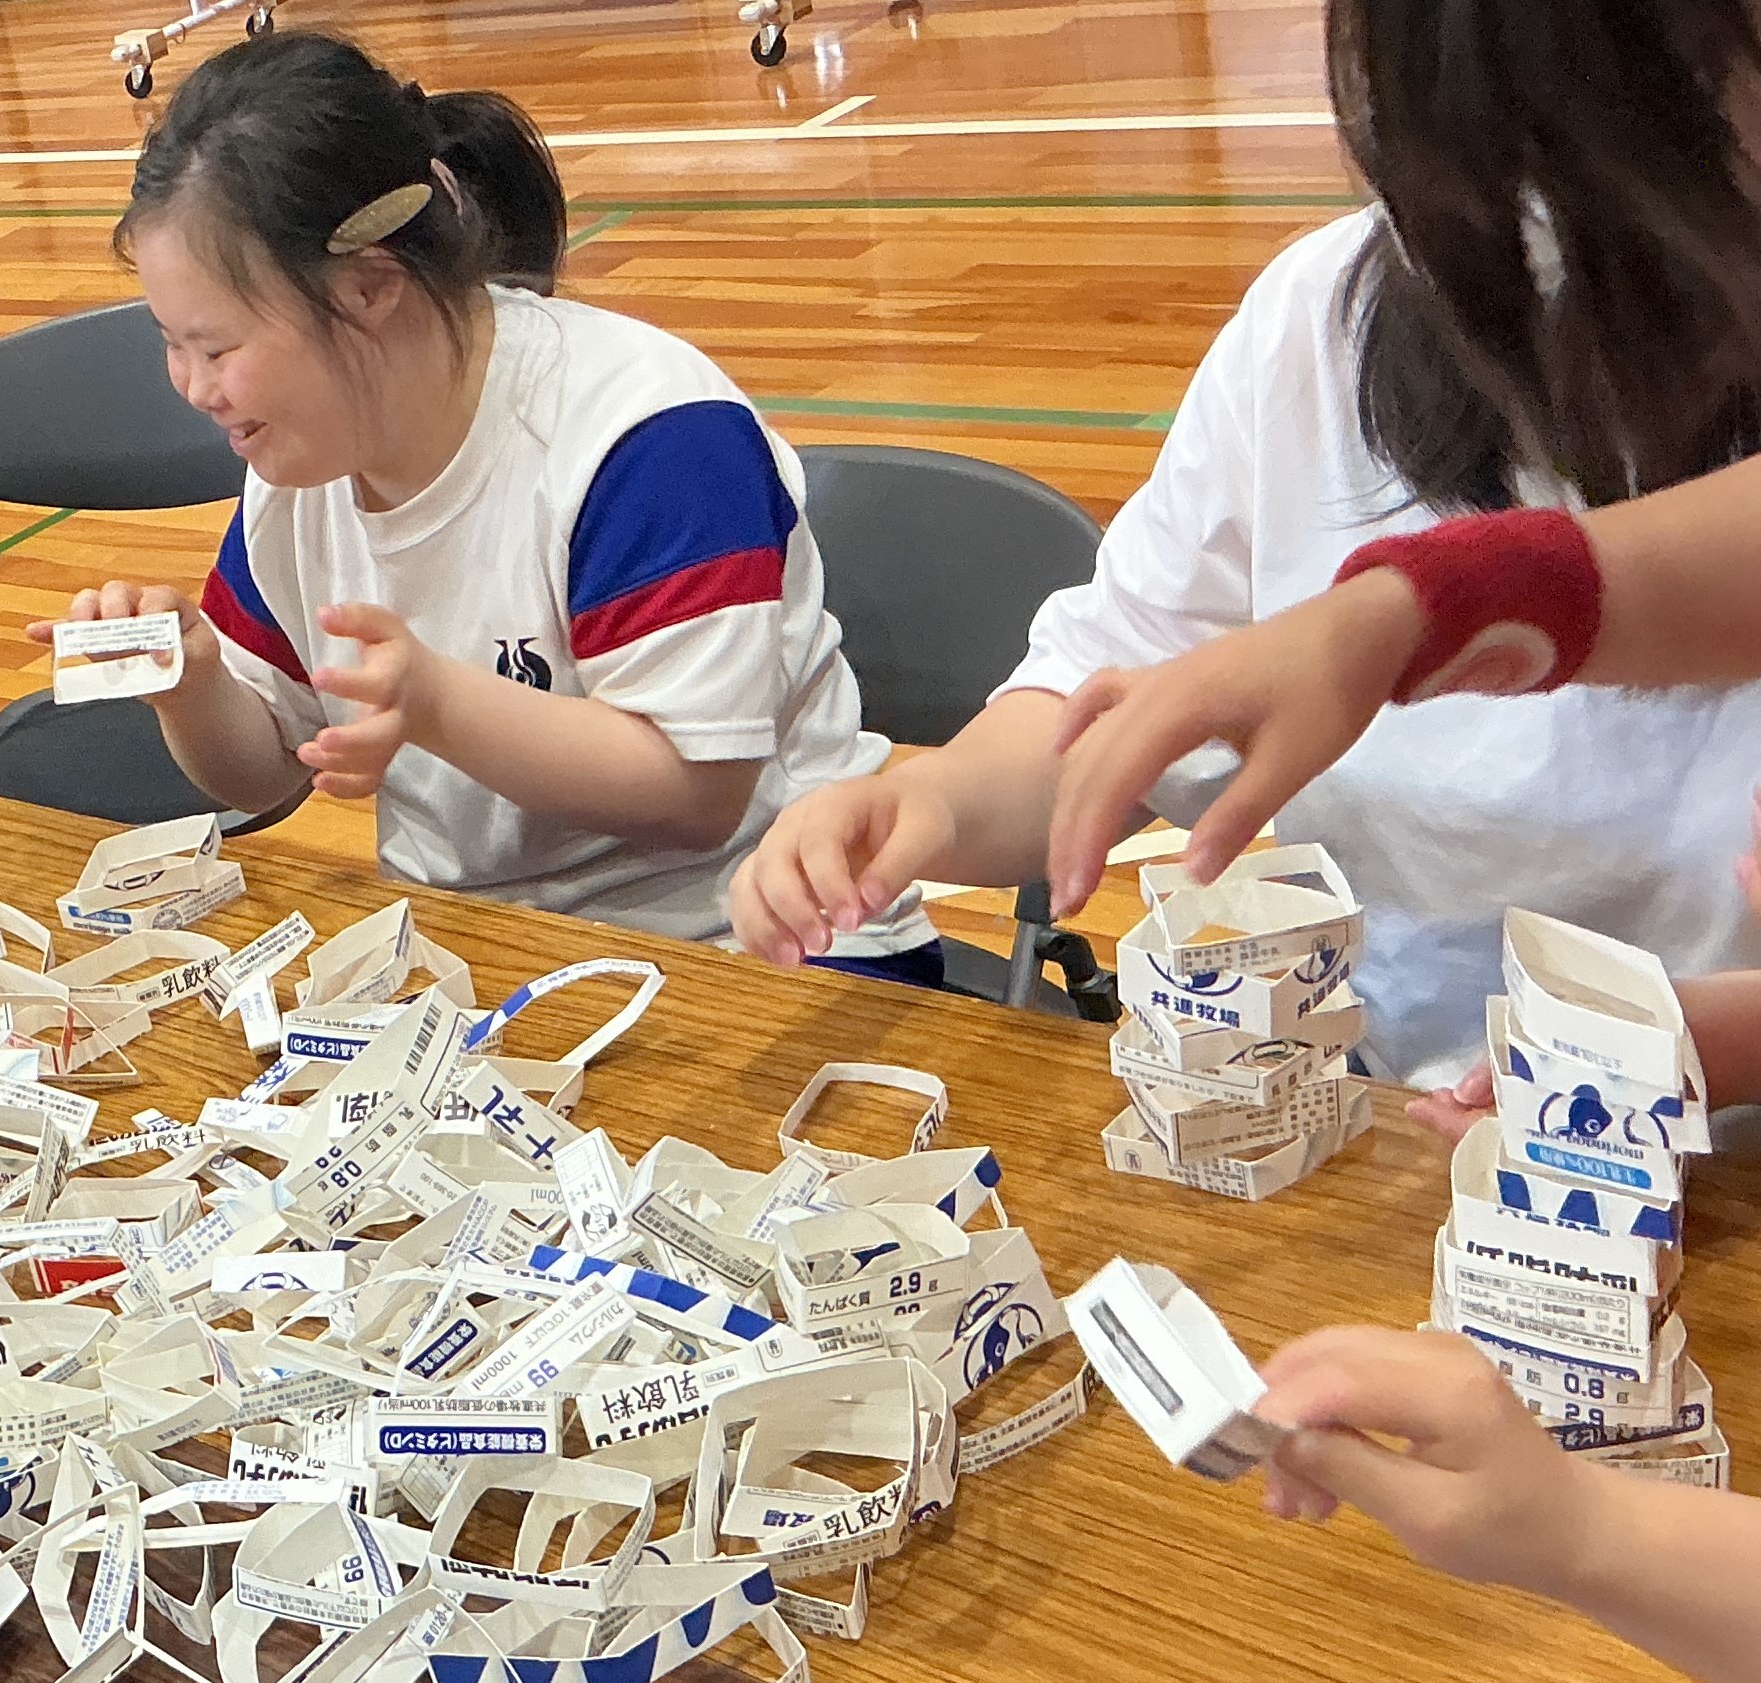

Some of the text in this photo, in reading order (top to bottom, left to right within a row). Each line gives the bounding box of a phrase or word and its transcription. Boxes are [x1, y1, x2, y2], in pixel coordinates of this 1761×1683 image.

[161, 955, 221, 998] 乳飲料
[1150, 989, 1241, 1030] 共進牧場
[329, 1159, 362, 1189] 0.8
[888, 1270, 922, 1299] 2.9
[471, 1352, 519, 1392] 1000ml
[526, 1357, 560, 1389] 99
[1563, 1371, 1605, 1400] 0.8
[601, 1369, 702, 1425] 乳飲料
[384, 1429, 545, 1451] 栄養機能食品(ビタミンD)
